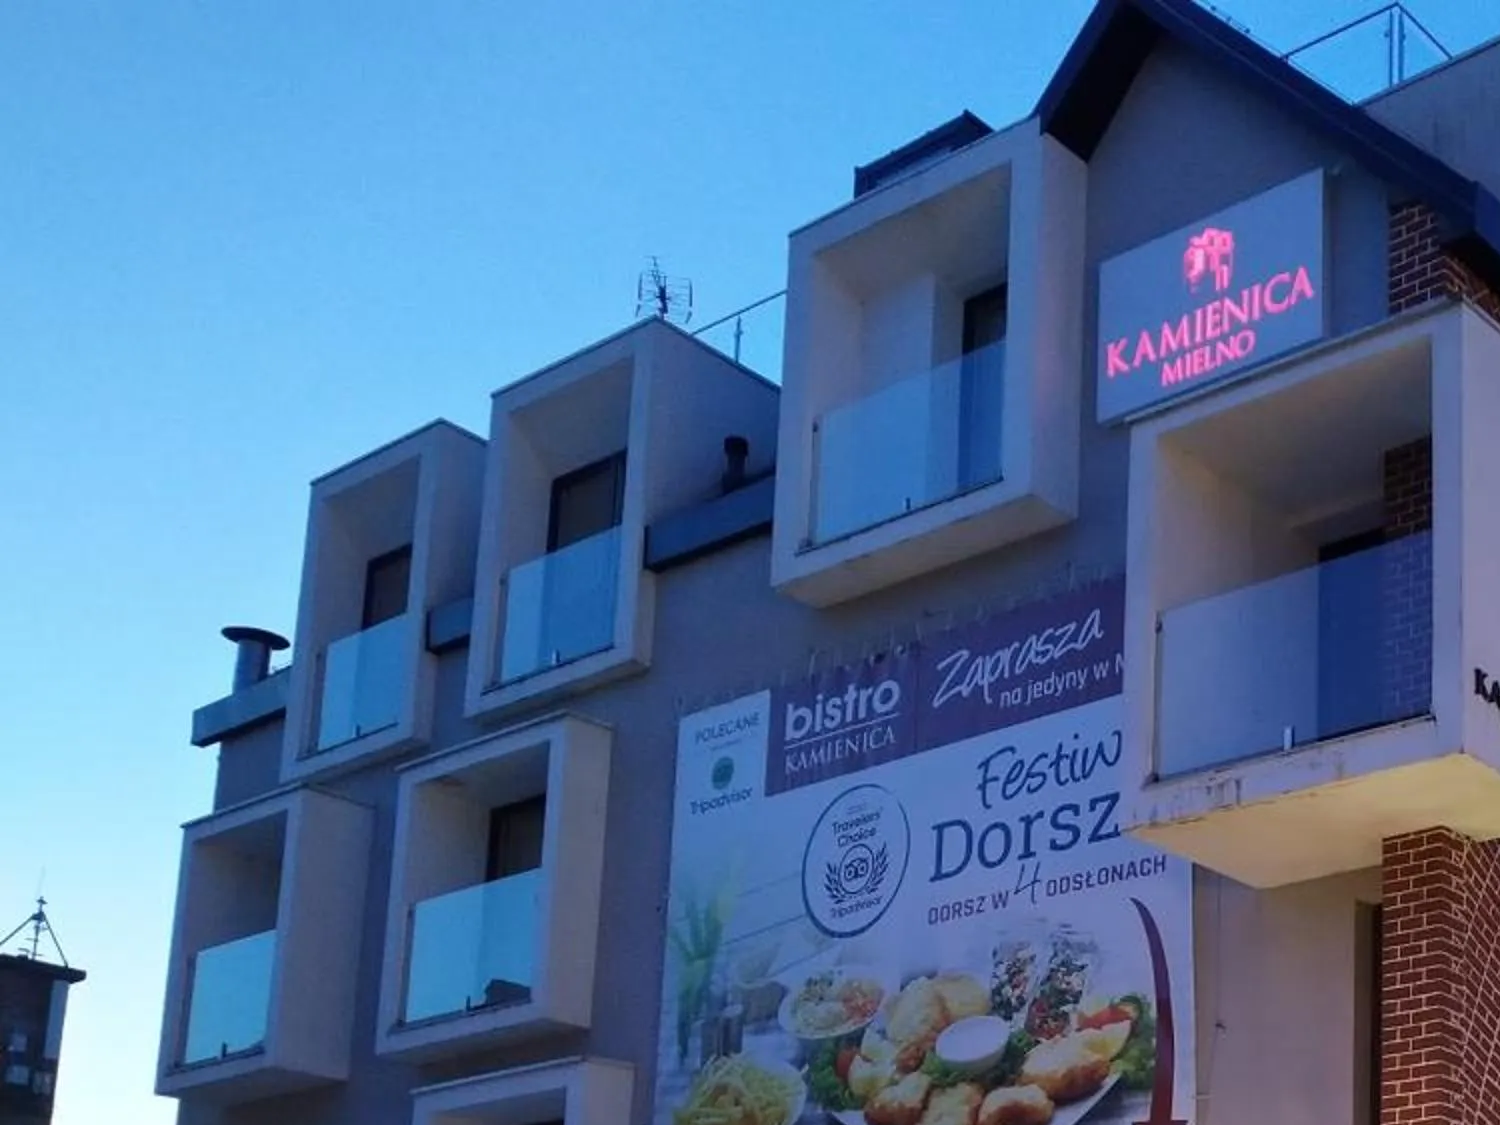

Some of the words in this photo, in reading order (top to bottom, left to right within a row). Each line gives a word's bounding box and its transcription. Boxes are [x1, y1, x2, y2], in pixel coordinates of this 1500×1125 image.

[1105, 266, 1315, 379] KAMIENICA
[1160, 329, 1257, 387] MIELNO
[932, 608, 1104, 708] Zaprasza
[999, 685, 1022, 708] na
[1024, 666, 1089, 706] jedyny
[1093, 661, 1110, 682] w
[784, 679, 901, 741] bistro
[784, 725, 897, 775] KAMIENICA
[928, 791, 1122, 883] Dorsz
[926, 894, 987, 926] DORSZ
[990, 890, 1011, 912] W
[1012, 860, 1042, 905] 4
[1045, 854, 1168, 898] ODSŁONACH
